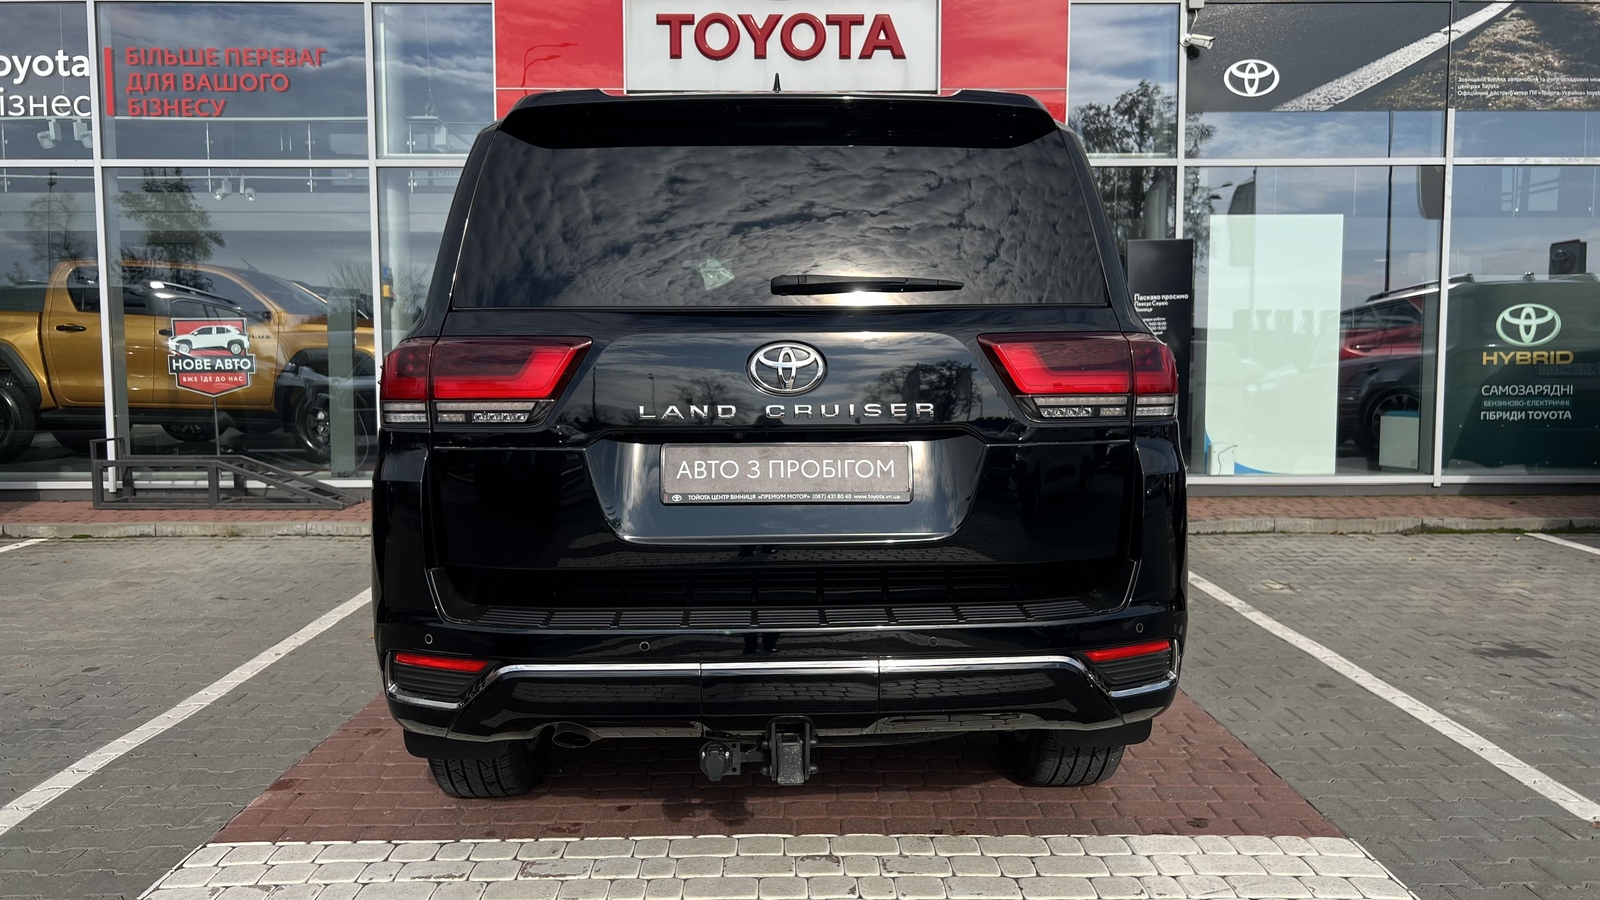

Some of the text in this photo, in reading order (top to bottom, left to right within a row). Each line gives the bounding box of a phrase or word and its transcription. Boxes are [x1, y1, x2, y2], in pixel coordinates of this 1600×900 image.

[656, 12, 906, 61] TOYOTA
[125, 47, 326, 67] БІЛЬШЕ ПЕРЕВАГ
[126, 73, 290, 94] ДЛЯ ВАШОГО
[127, 98, 226, 117] БІЗНЕСУ
[1161, 293, 1189, 301] просимо
[172, 358, 251, 371] НОВЕ АВТО
[1482, 350, 1574, 366] HYBRID
[200, 375, 212, 383] ЇДЕ
[1481, 384, 1574, 397] САМОЗАРЯДНІ
[1483, 399, 1570, 407] БЕНЗИНОВО-ЕЛЕКТРИЧНІ
[638, 402, 936, 420] LAND CRUISER
[1480, 410, 1572, 421] ГІБРИДИ TOYOTA
[676, 459, 895, 480] АВТО З ПРОБІГОМ
[688, 493, 711, 501] ТОЙОТА
[711, 493, 729, 501] ЦЕНТР
[730, 493, 756, 501] ВІННИЦЯ
[853, 493, 901, 501] www.toyota.vn.ua
